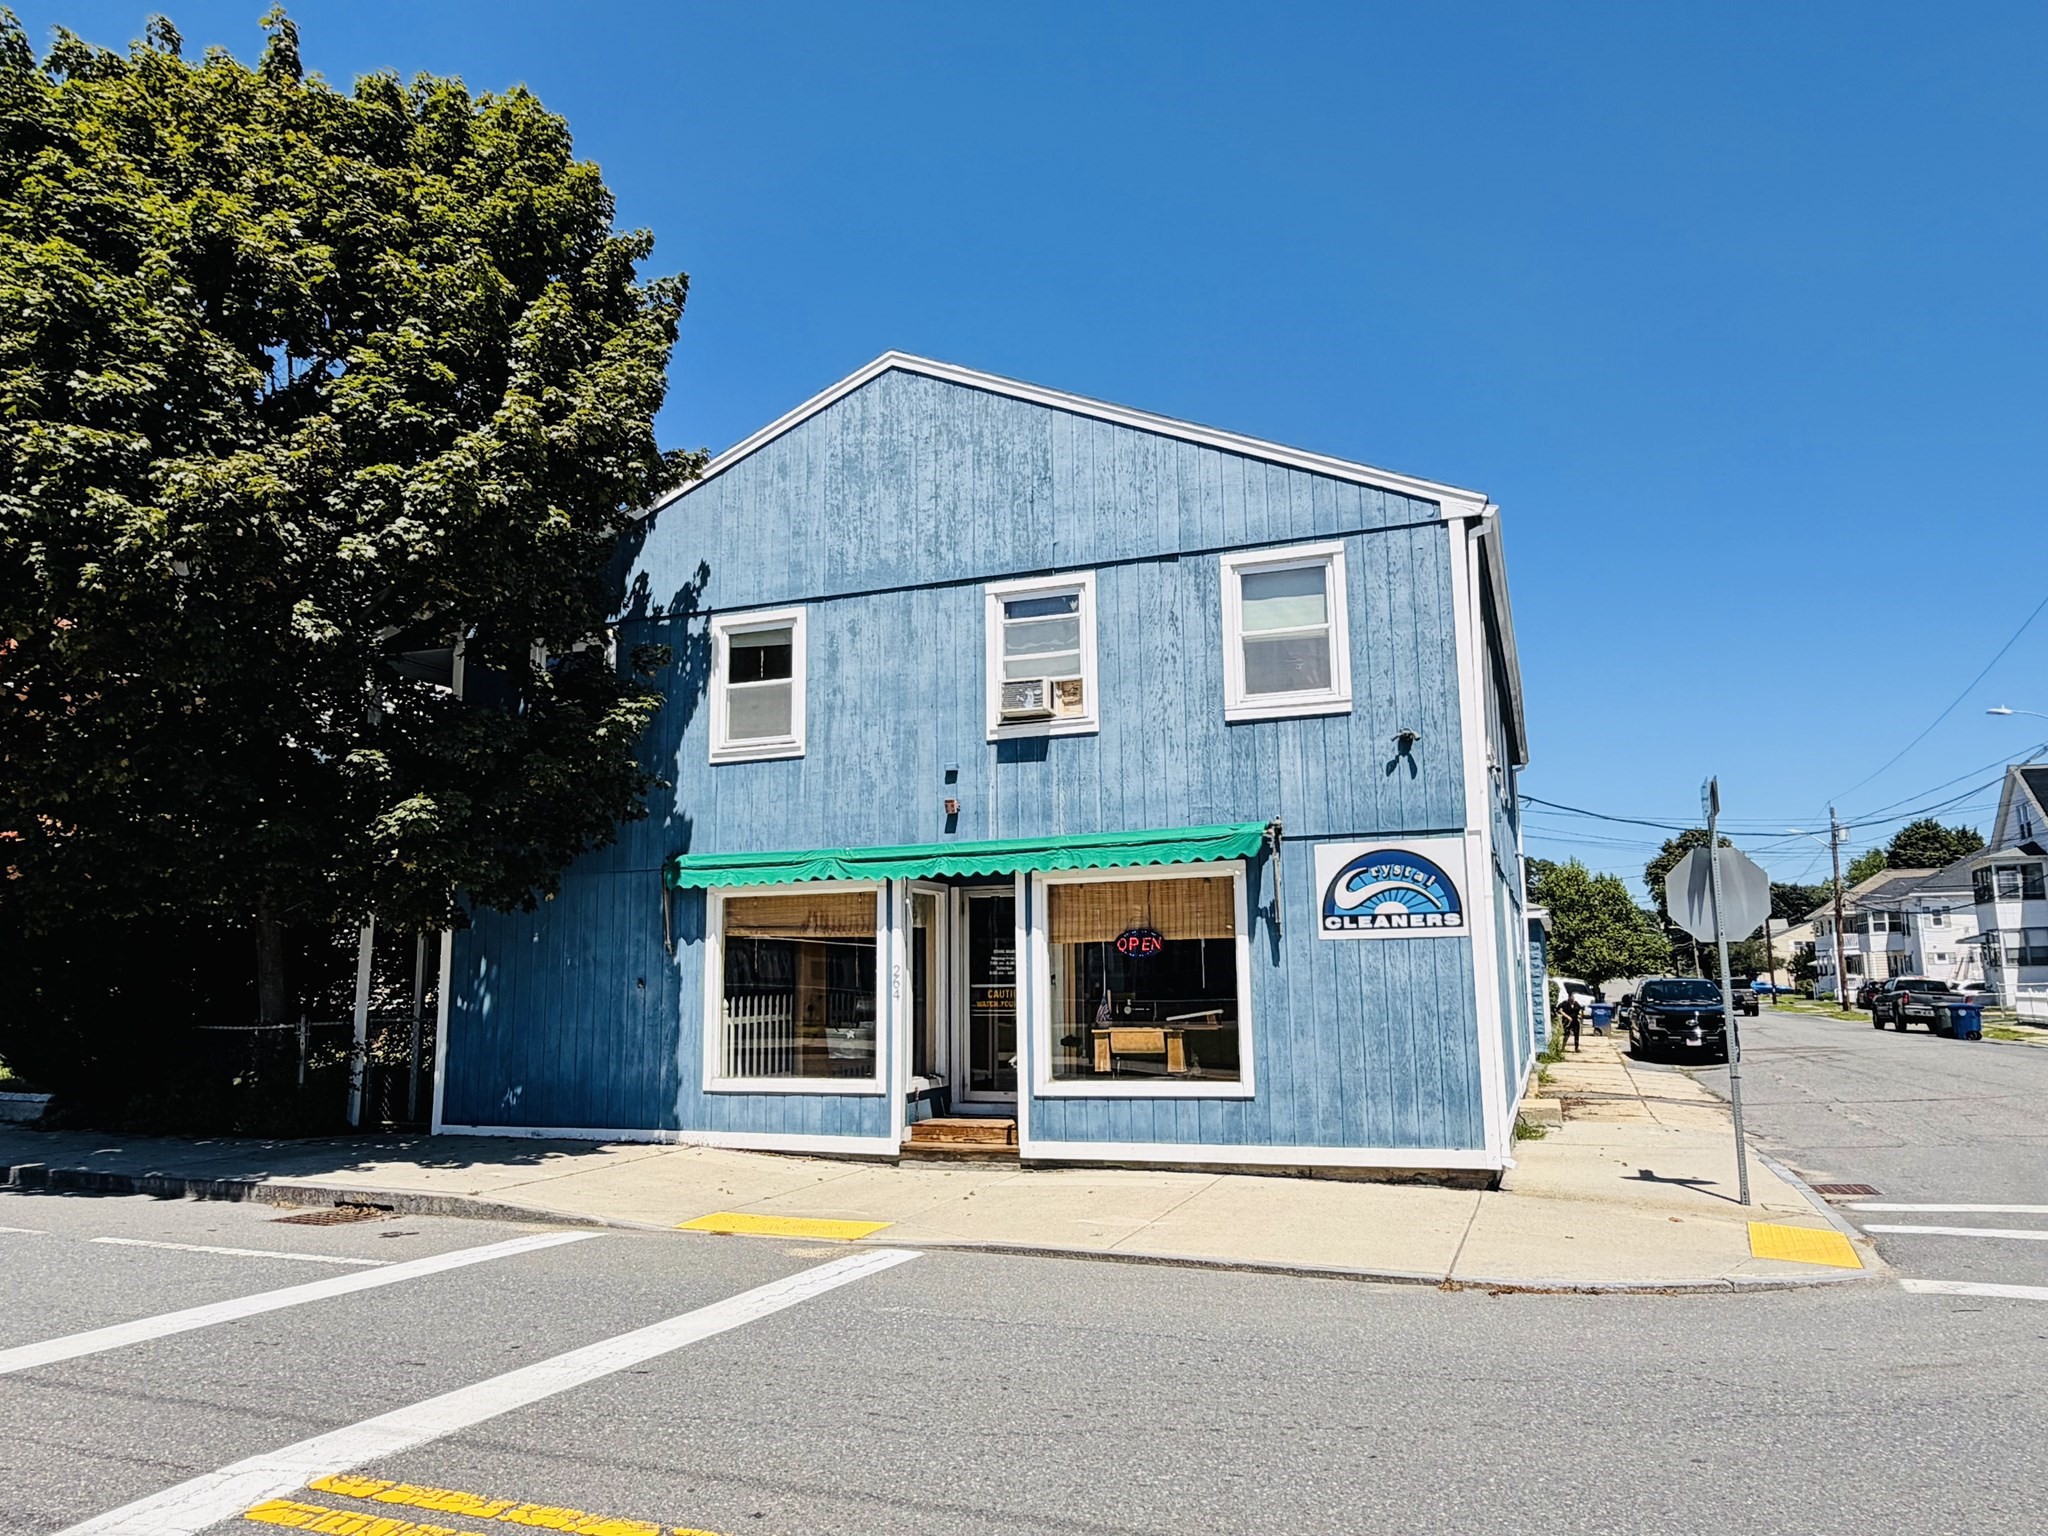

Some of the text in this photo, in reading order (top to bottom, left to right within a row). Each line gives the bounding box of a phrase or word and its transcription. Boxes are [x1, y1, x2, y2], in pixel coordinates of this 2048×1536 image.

[1334, 863, 1442, 910] Crystal
[1325, 913, 1461, 929] CLEANERS
[1116, 936, 1162, 953] OPEN
[988, 989, 1016, 999] CAUTI
[1000, 1000, 1016, 1008] YOU
